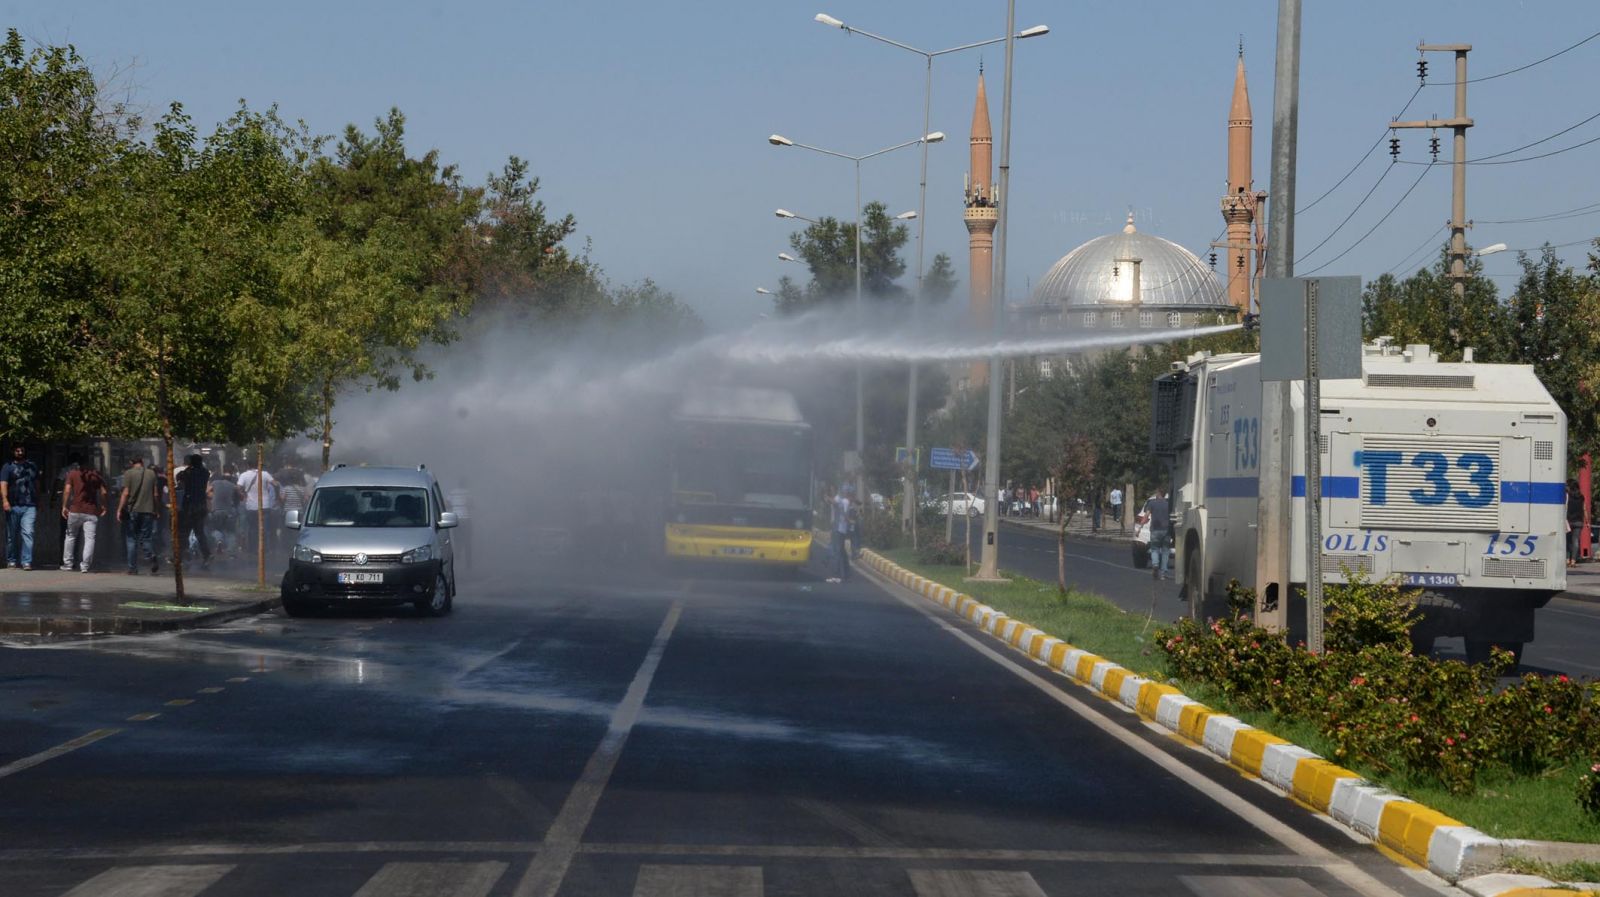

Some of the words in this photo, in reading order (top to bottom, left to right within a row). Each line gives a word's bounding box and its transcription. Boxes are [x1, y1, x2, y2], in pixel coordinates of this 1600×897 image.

[1233, 417, 1258, 471] T33
[1353, 450, 1496, 508] T33
[1320, 528, 1388, 552] OLİS
[1483, 532, 1538, 556] 155
[368, 573, 380, 581] 711
[1418, 575, 1426, 584] A
[1429, 575, 1455, 584] 1340
